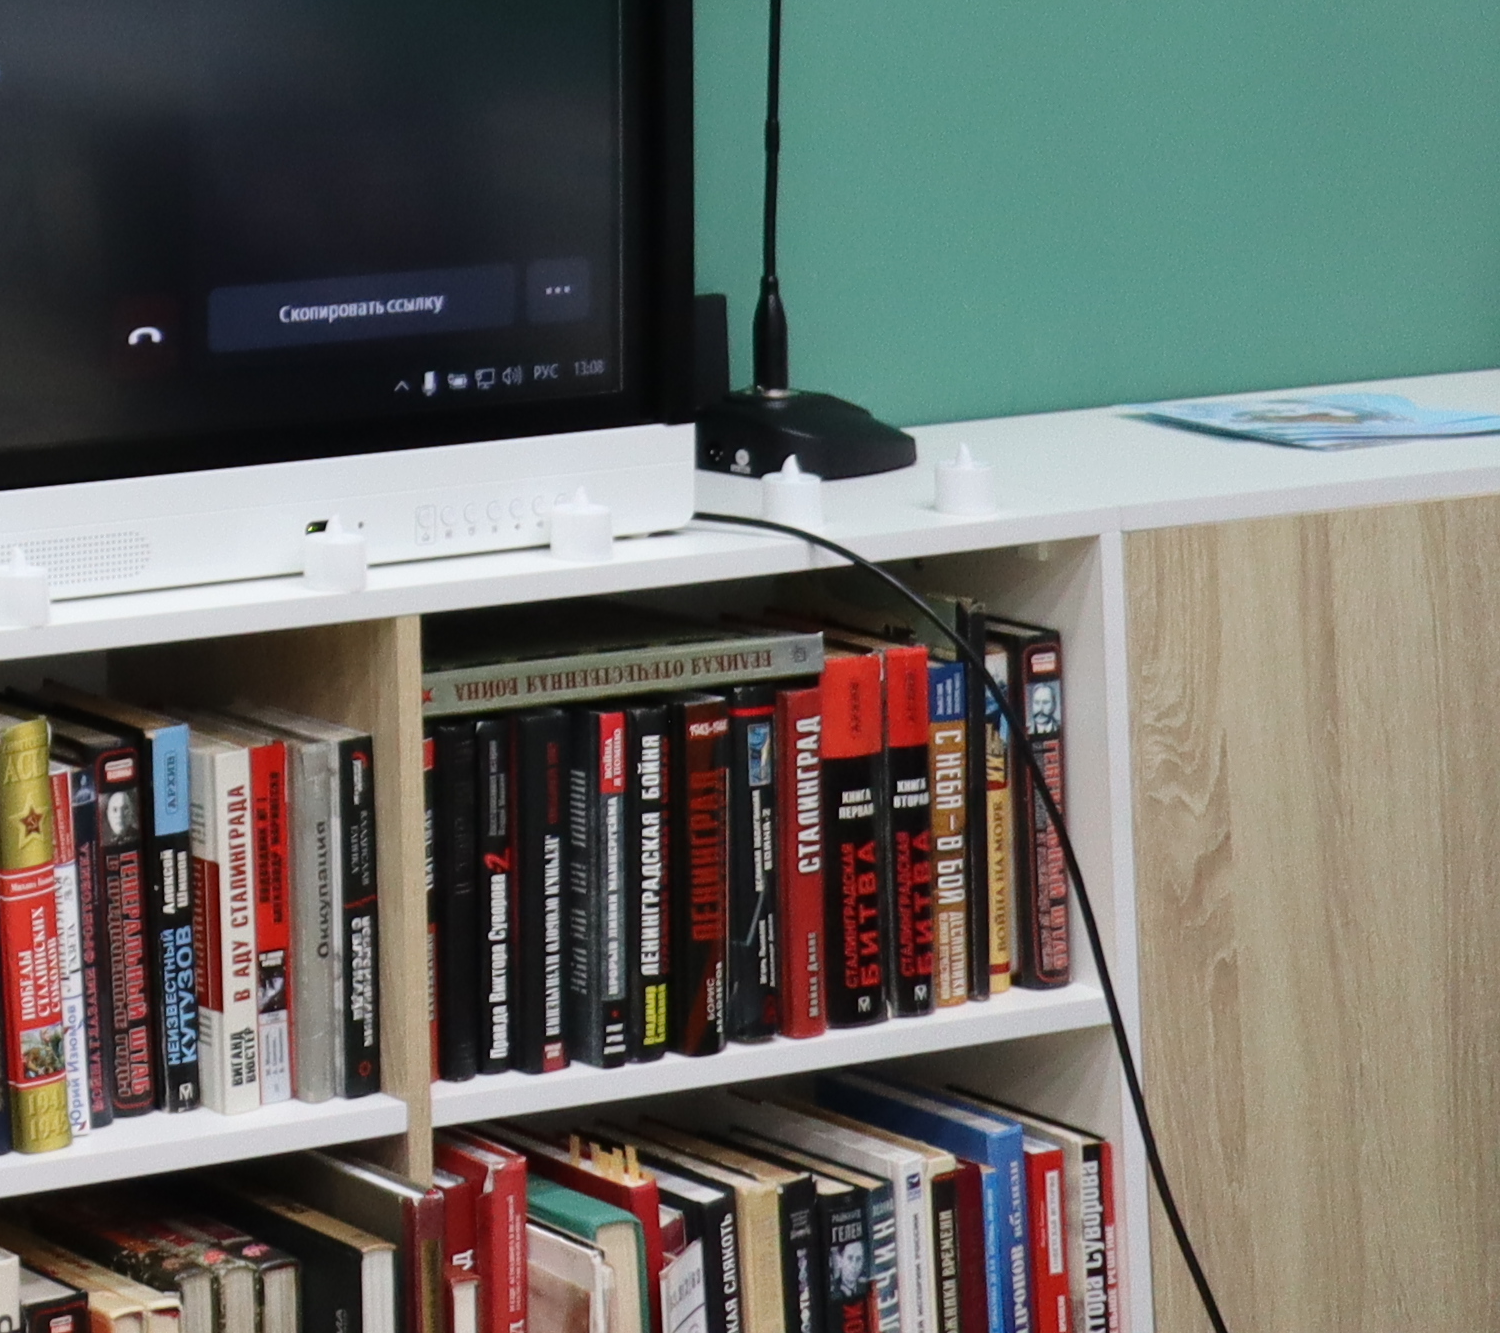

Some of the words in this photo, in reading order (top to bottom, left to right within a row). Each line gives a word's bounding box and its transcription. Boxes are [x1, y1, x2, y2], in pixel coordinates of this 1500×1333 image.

[279, 299, 385, 324] Скопировать
[387, 293, 445, 319] ссылку
[533, 362, 559, 381] РУС
[637, 735, 659, 800] БОЙНЯ
[797, 715, 821, 873] СТАЛИНГРАД
[639, 812, 662, 976] ЛЕНИНГРАДСКАЯ
[159, 929, 180, 1065] НЕИЗВЕСТНЫЙ
[175, 925, 196, 1065] КУТУЗОВ
